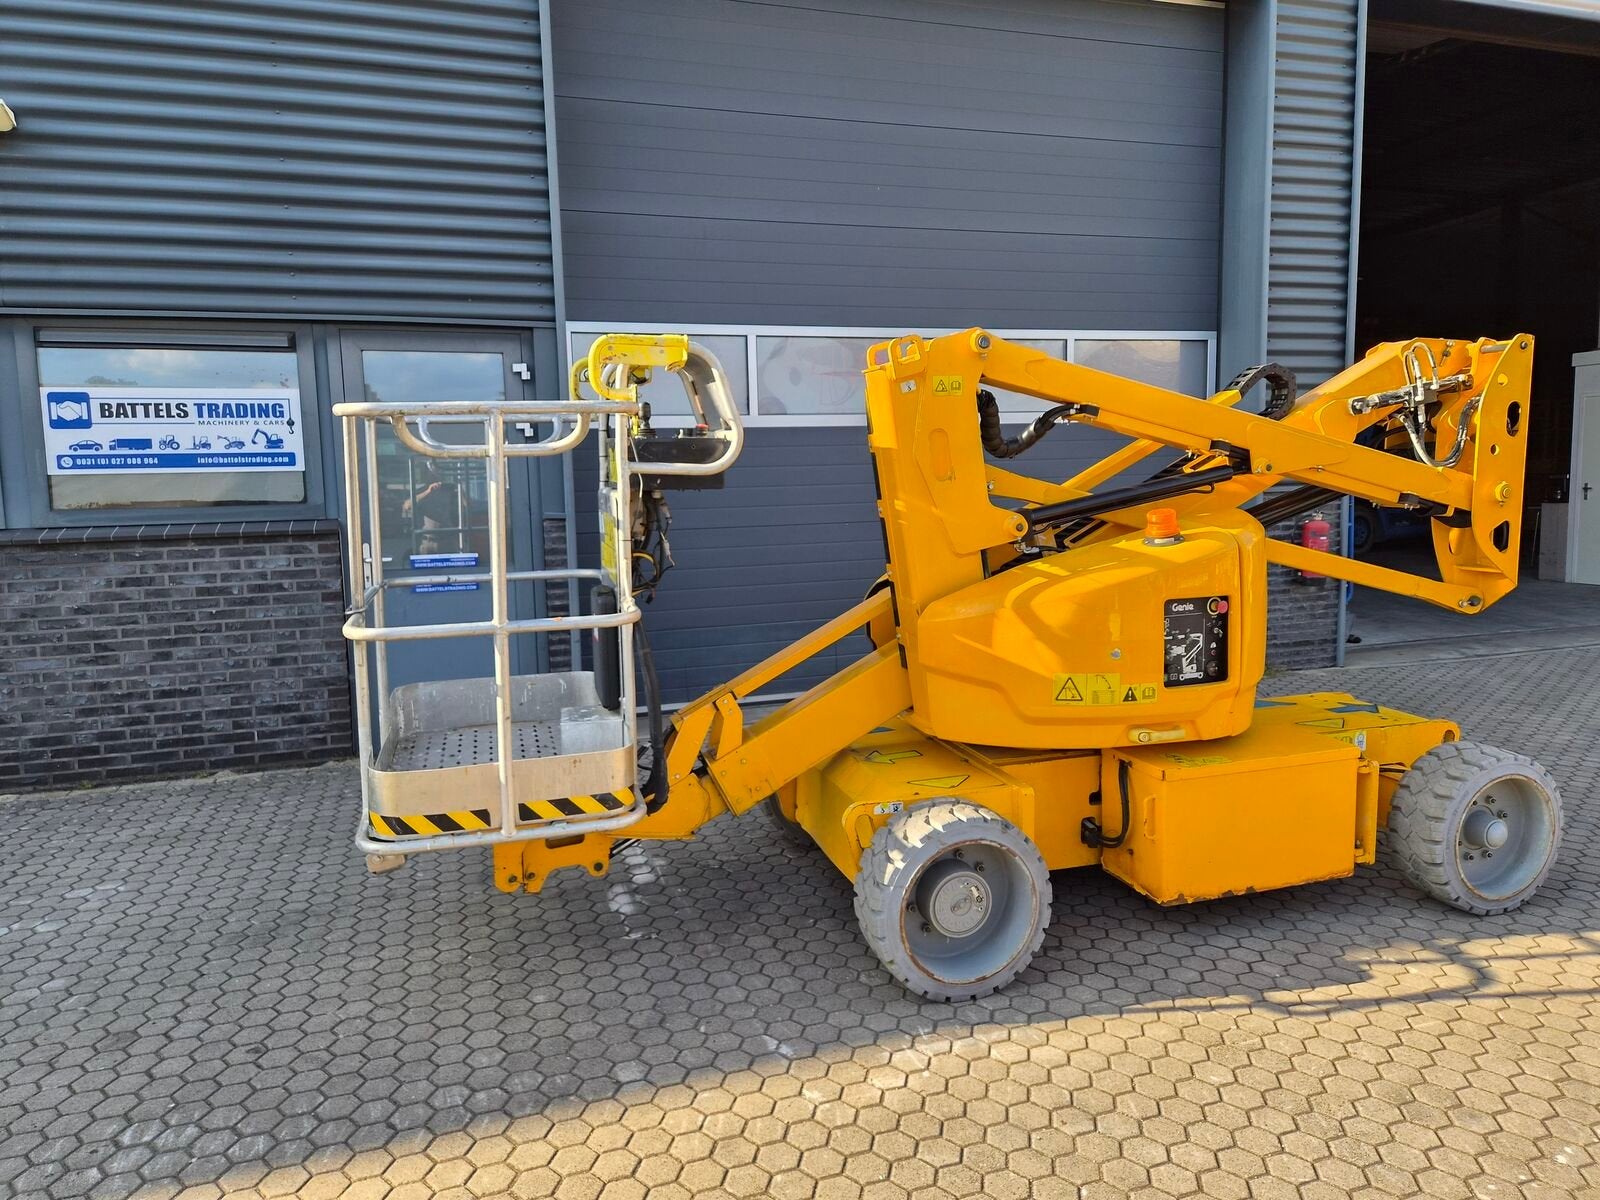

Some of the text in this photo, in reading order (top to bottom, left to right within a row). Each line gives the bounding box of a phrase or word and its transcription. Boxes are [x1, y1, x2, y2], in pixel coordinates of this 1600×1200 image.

[99, 402, 285, 419] BATTELS TRADING
[1172, 603, 1194, 611] Genie
